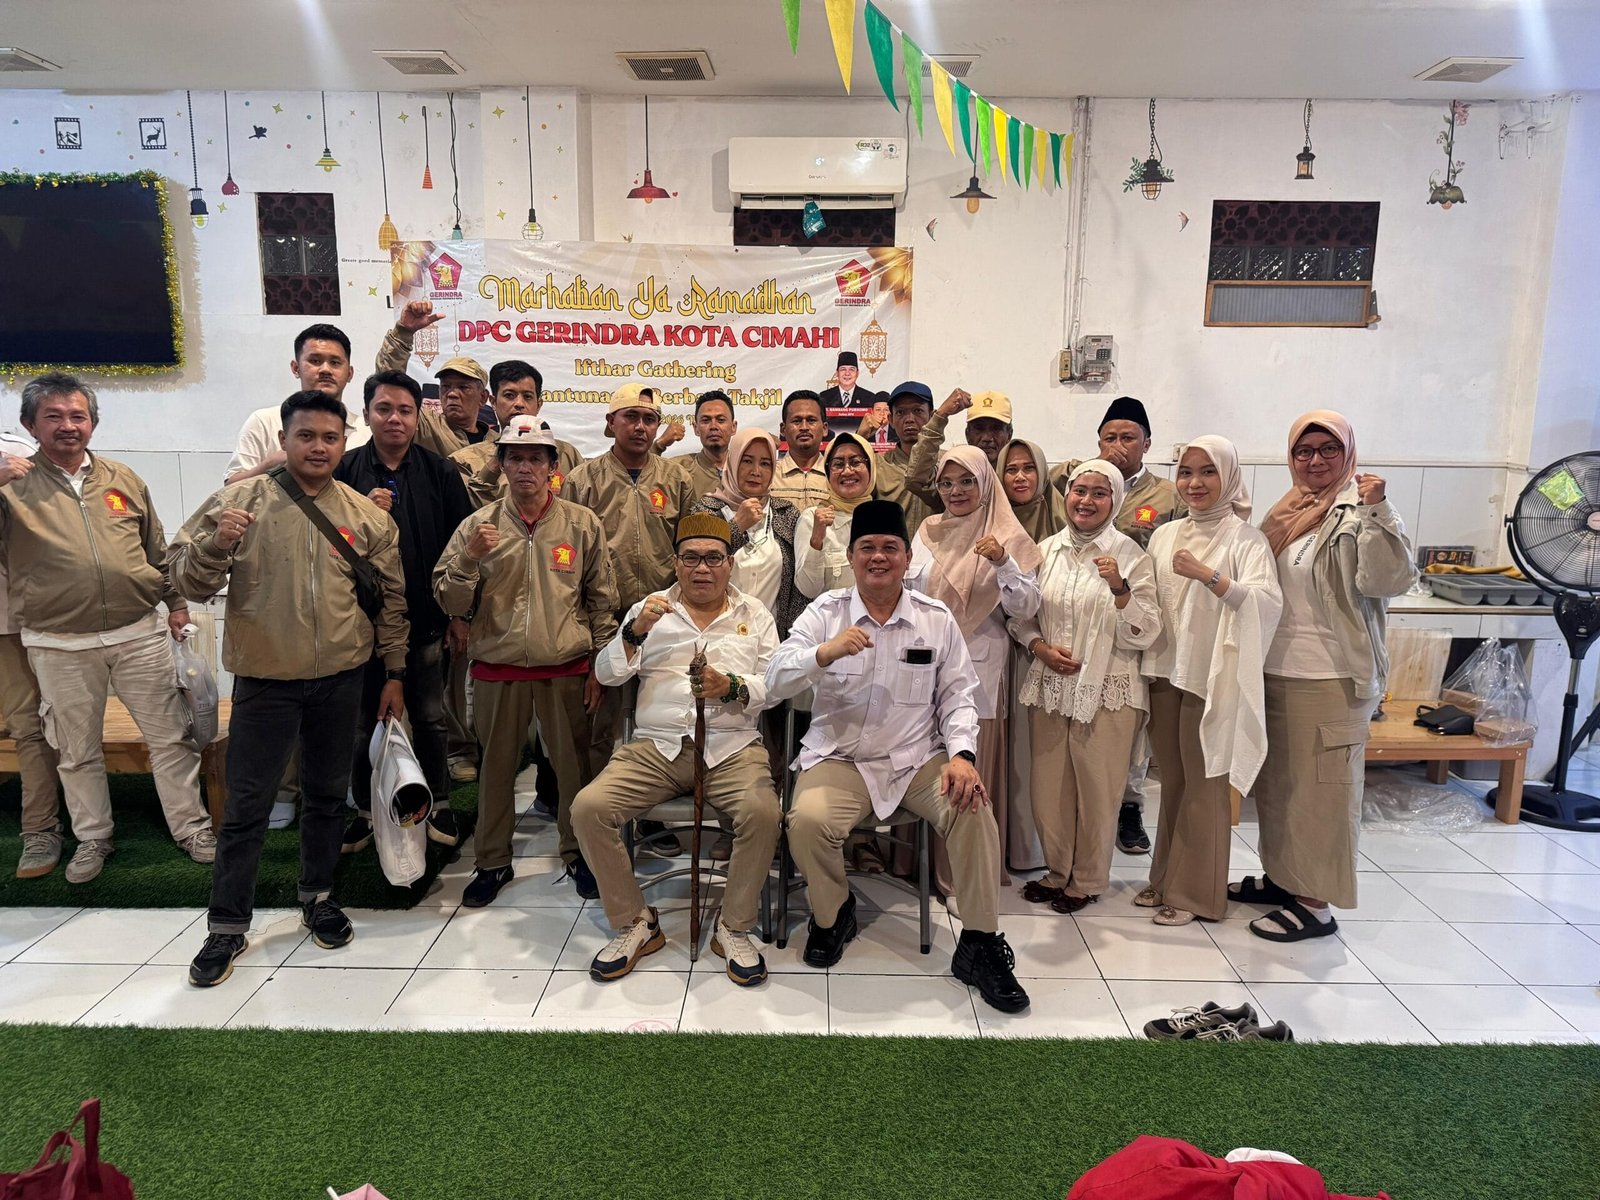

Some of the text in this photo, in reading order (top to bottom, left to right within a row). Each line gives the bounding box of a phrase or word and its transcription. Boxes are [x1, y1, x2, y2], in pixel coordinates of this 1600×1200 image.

[478, 273, 816, 320] Marhaban Ya Ramadhan
[458, 320, 840, 349] DPC GERINDRA KOTA CIMAHI
[574, 358, 737, 383] Ifthar Gathering
[541, 387, 614, 403] antuna
[727, 388, 783, 410] Takjil
[1293, 534, 1317, 566] GERINDRA
